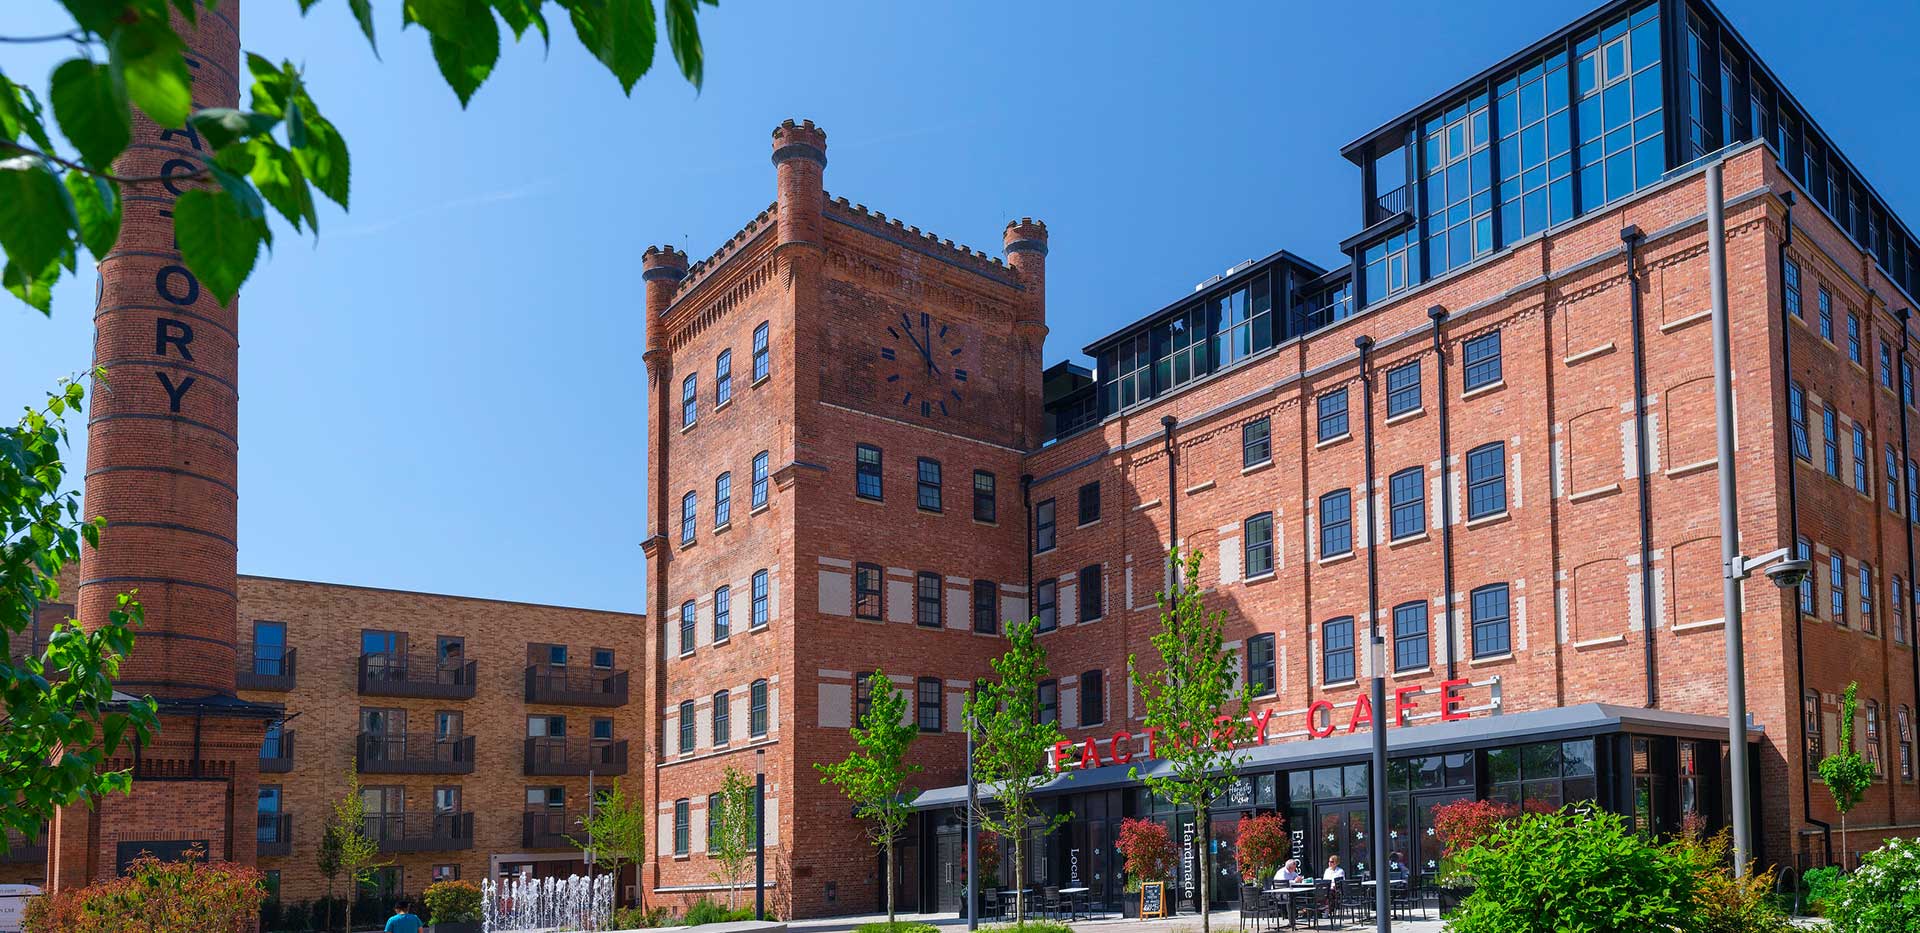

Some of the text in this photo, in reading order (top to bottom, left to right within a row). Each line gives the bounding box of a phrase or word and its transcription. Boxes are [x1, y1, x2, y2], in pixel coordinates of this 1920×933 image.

[1306, 678, 1471, 738] CAFE
[1070, 848, 1080, 882] Local
[1183, 822, 1195, 899] Handmade
[1292, 830, 1304, 876] Ethica
